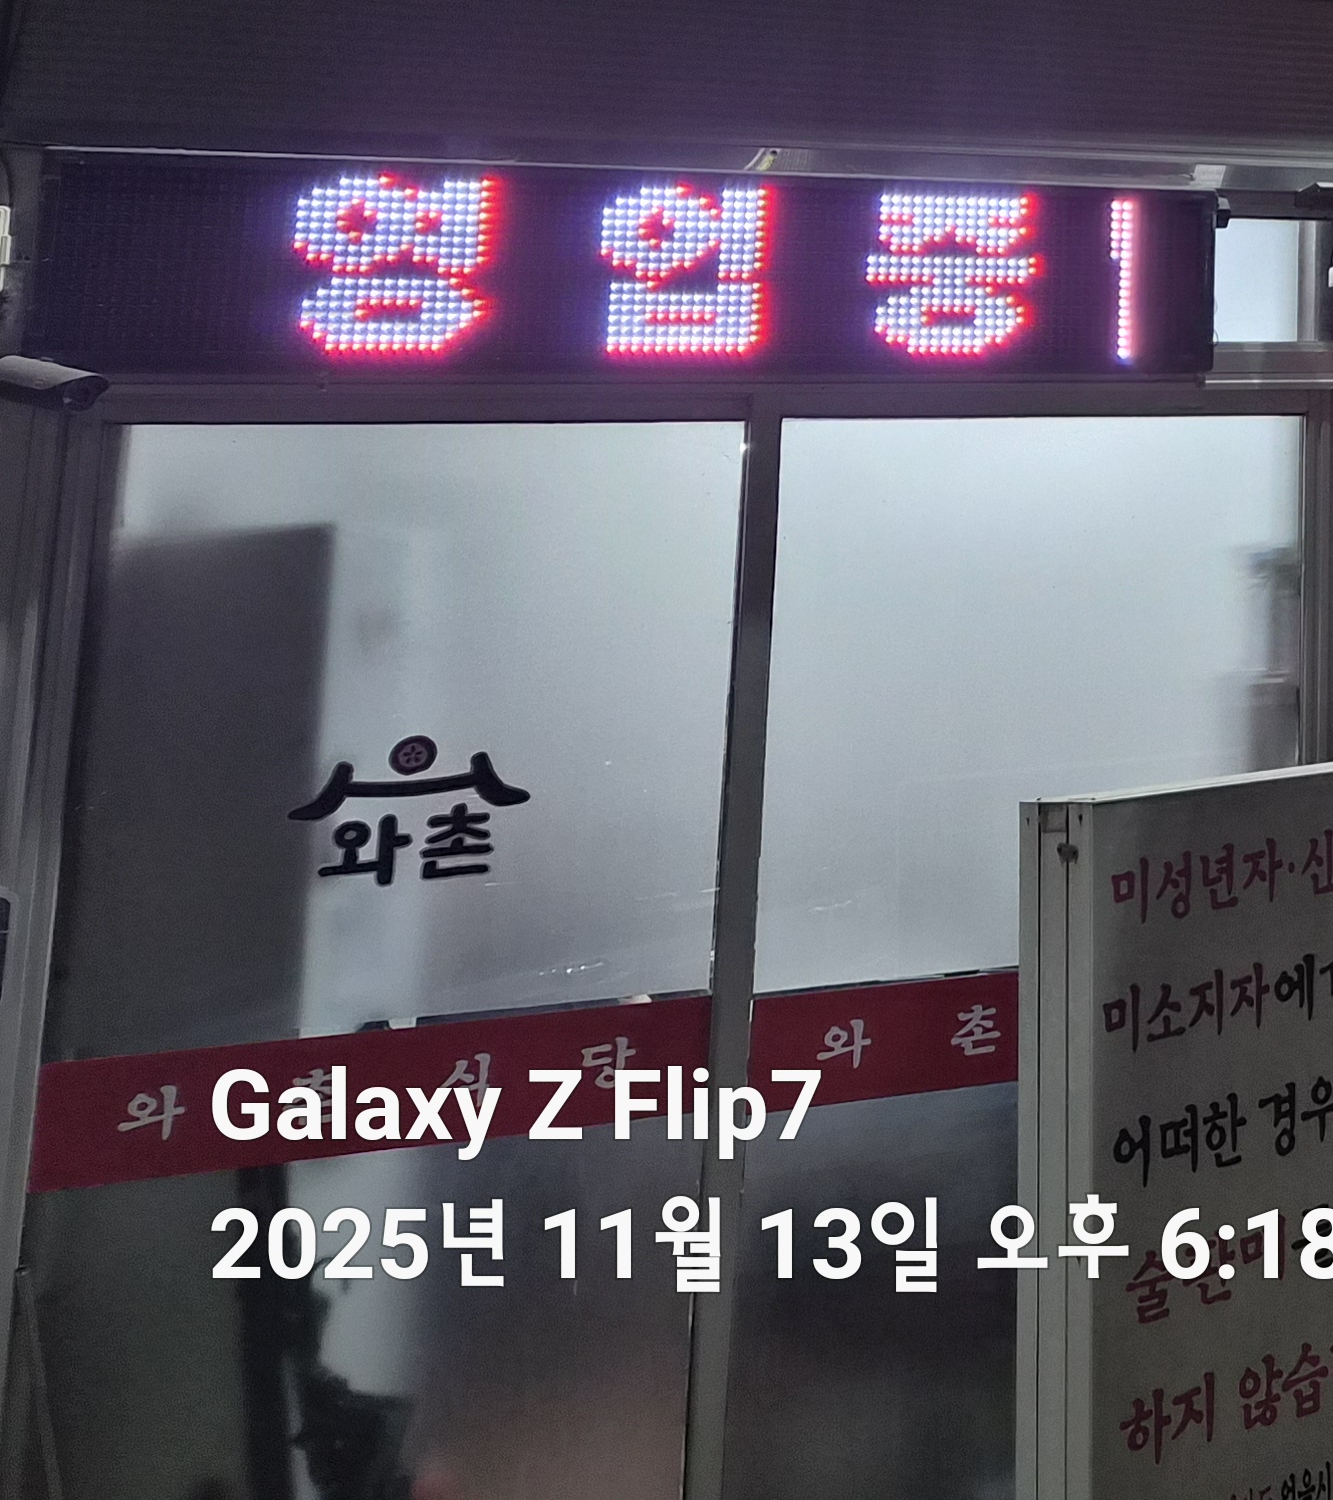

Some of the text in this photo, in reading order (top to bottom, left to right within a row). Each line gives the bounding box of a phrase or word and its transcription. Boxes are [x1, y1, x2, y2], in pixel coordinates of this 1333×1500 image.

[292, 170, 1046, 362] 영업중
[319, 802, 493, 886] 와촌
[1113, 1092, 1247, 1187] 어떠한
[1119, 1372, 1215, 1465] 하지
